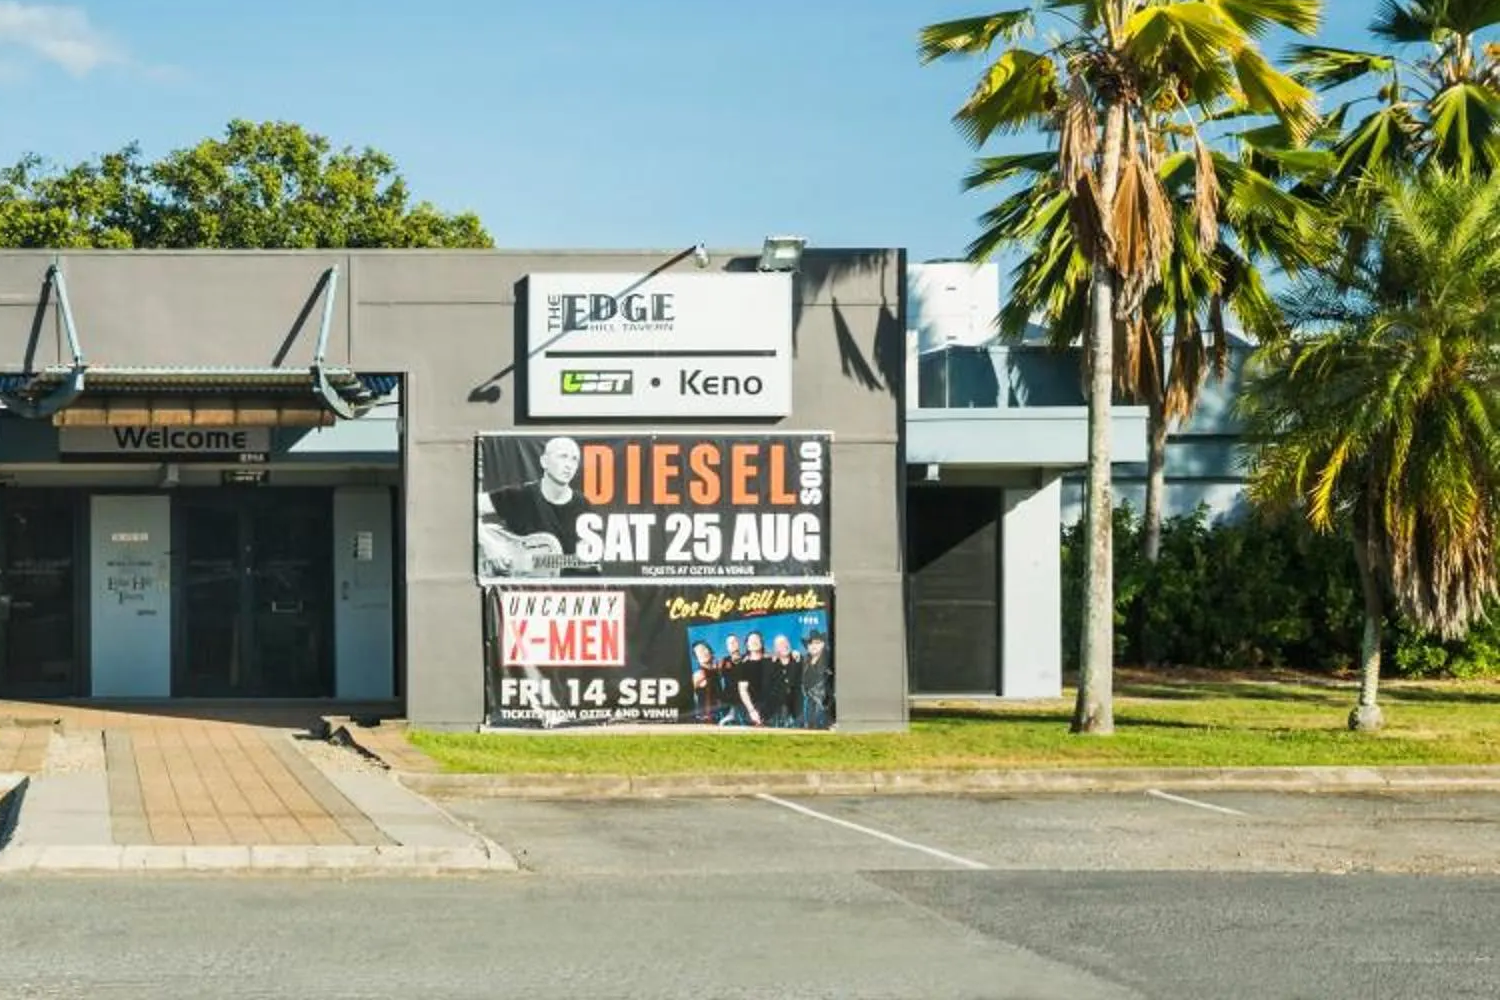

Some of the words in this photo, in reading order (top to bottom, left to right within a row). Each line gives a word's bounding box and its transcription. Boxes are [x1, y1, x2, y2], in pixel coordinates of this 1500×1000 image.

[547, 294, 561, 332] THE
[562, 294, 676, 331] EDGE
[680, 369, 763, 395] Keno
[114, 427, 247, 449] Welcome
[582, 444, 798, 505] DIESEL
[800, 441, 823, 505] SOLO
[575, 513, 656, 562] SAT
[665, 513, 722, 562] 25
[731, 513, 822, 562] AUG
[510, 596, 617, 616] UNCANNY
[700, 593, 735, 619] Life
[738, 590, 773, 611] still
[509, 619, 619, 660] X-MEN
[501, 679, 551, 706] FRI
[567, 679, 607, 706] 14
[618, 678, 680, 705] SEP
[643, 708, 679, 718] VENUE
